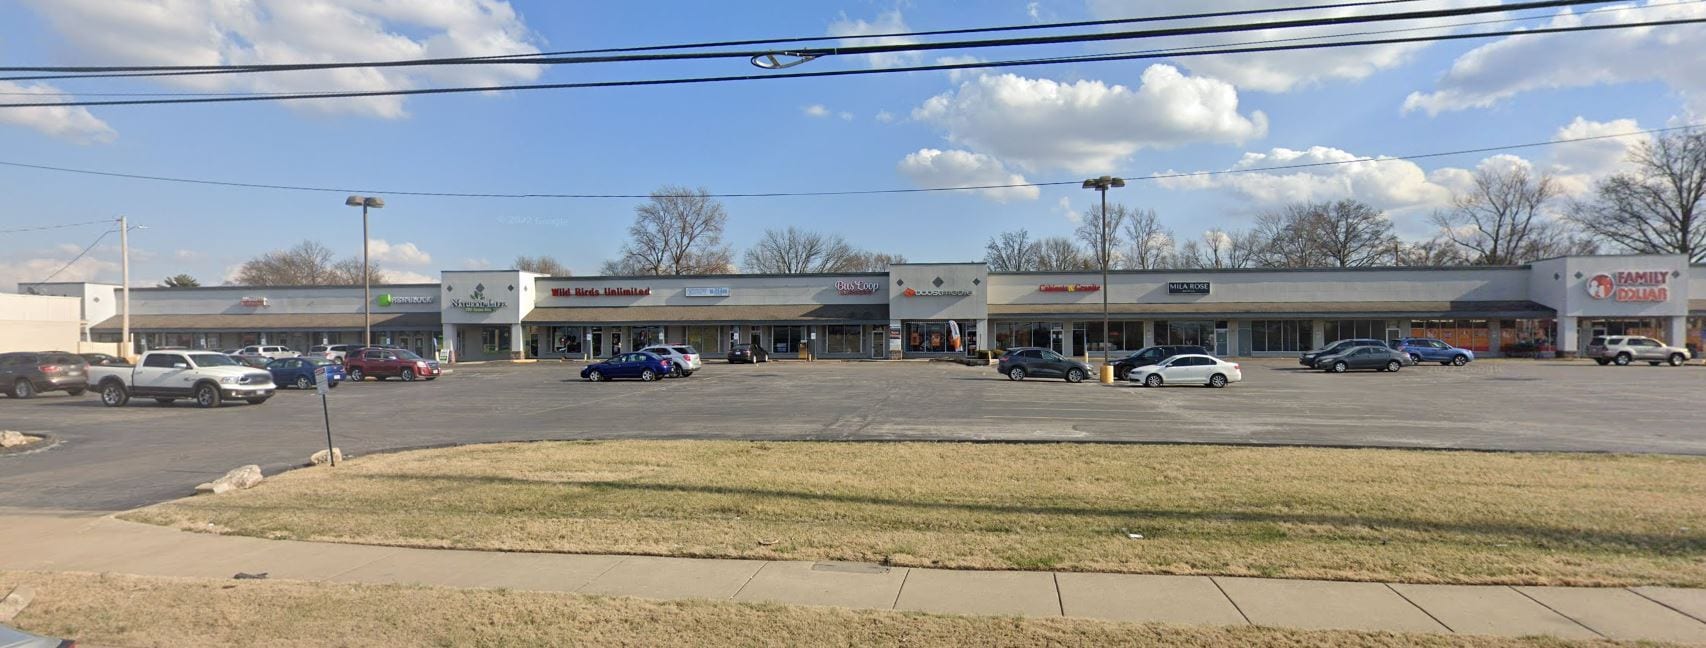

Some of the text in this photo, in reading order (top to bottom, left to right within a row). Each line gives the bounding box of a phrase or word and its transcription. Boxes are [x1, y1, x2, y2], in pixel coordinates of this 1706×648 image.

[1617, 271, 1669, 285] FAMILY
[552, 287, 652, 296] Wild Birds Unlimited
[835, 280, 879, 292] Bus Loop
[1616, 287, 1668, 302] DOLLAR
